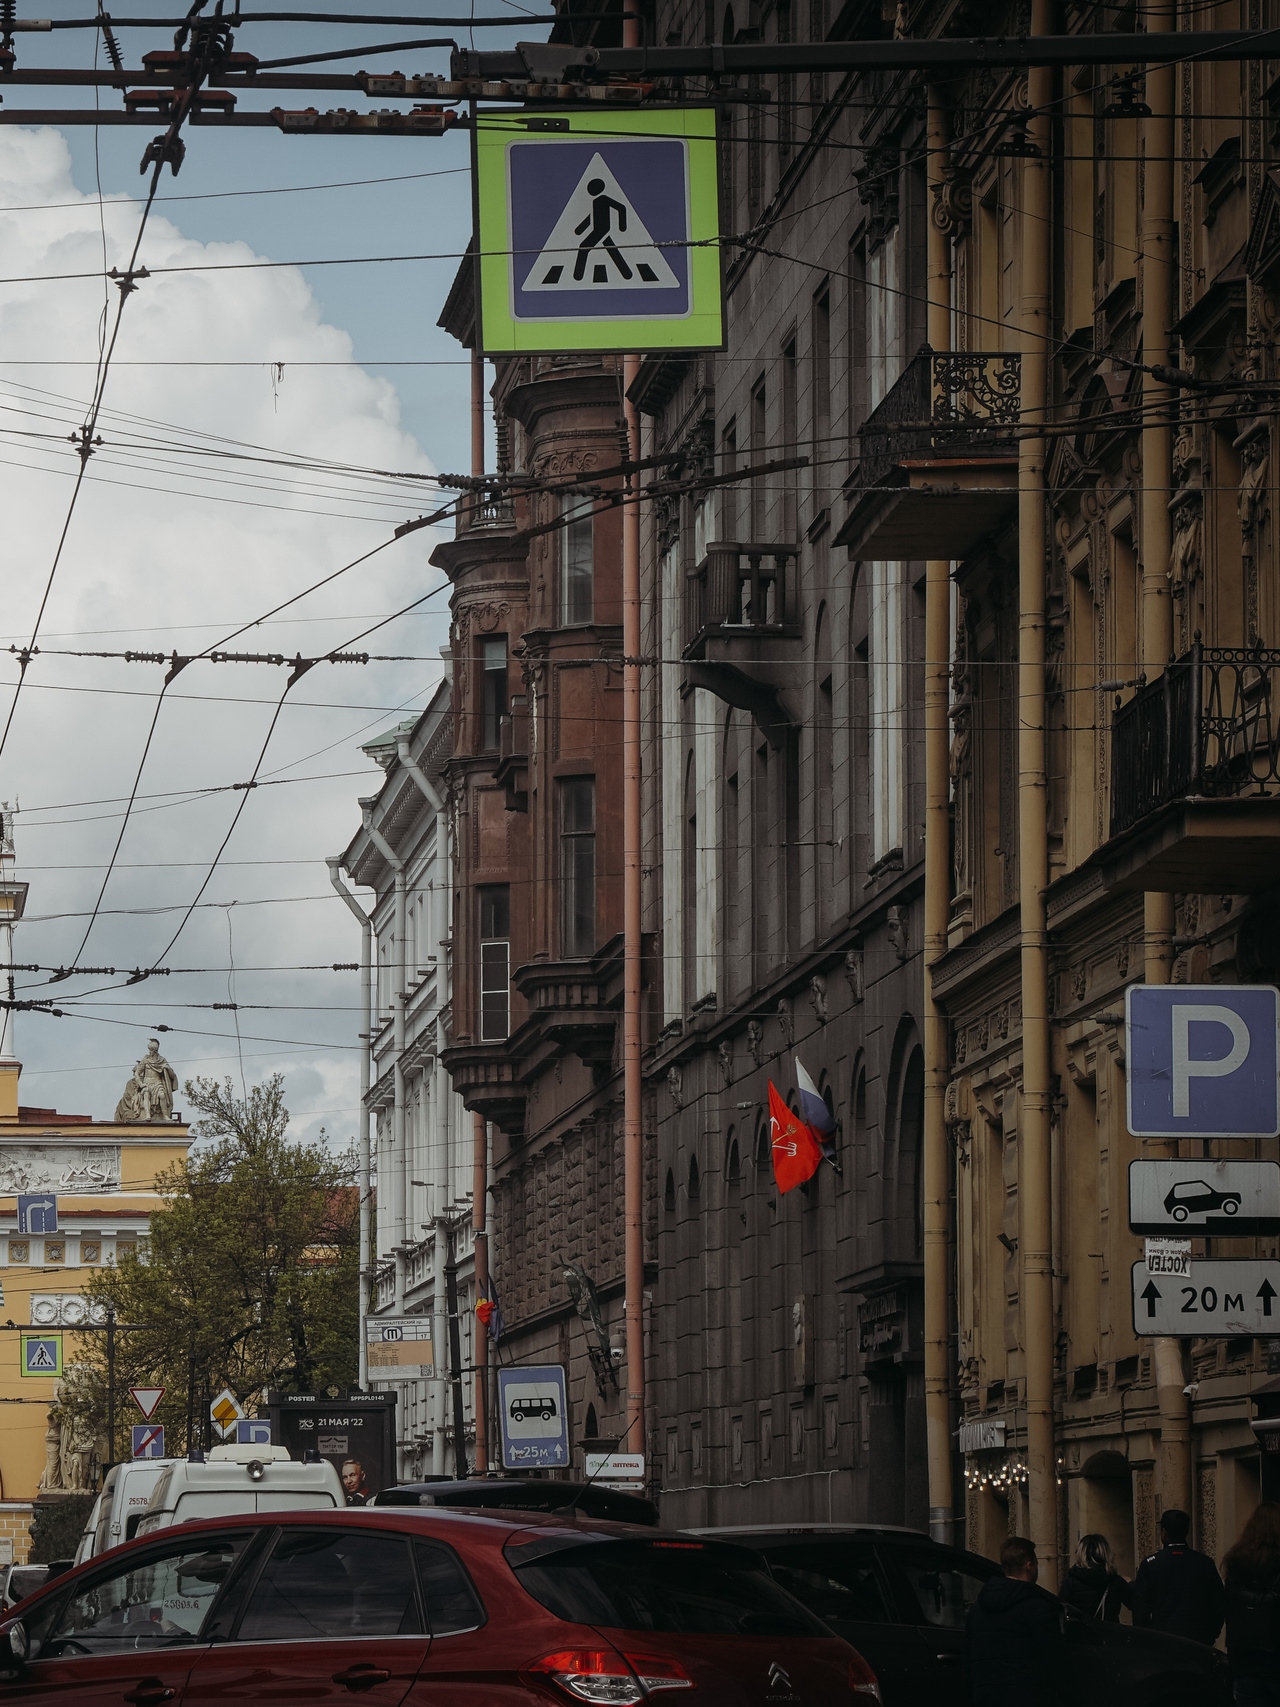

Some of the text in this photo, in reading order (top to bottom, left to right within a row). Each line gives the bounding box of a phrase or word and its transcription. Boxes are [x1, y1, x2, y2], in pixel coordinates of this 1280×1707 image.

[1171, 1004, 1251, 1118] P
[1148, 1255, 1187, 1273] ХОСТЕЛ
[318, 1418, 327, 1426] 21
[328, 1418, 349, 1426] МАЯ
